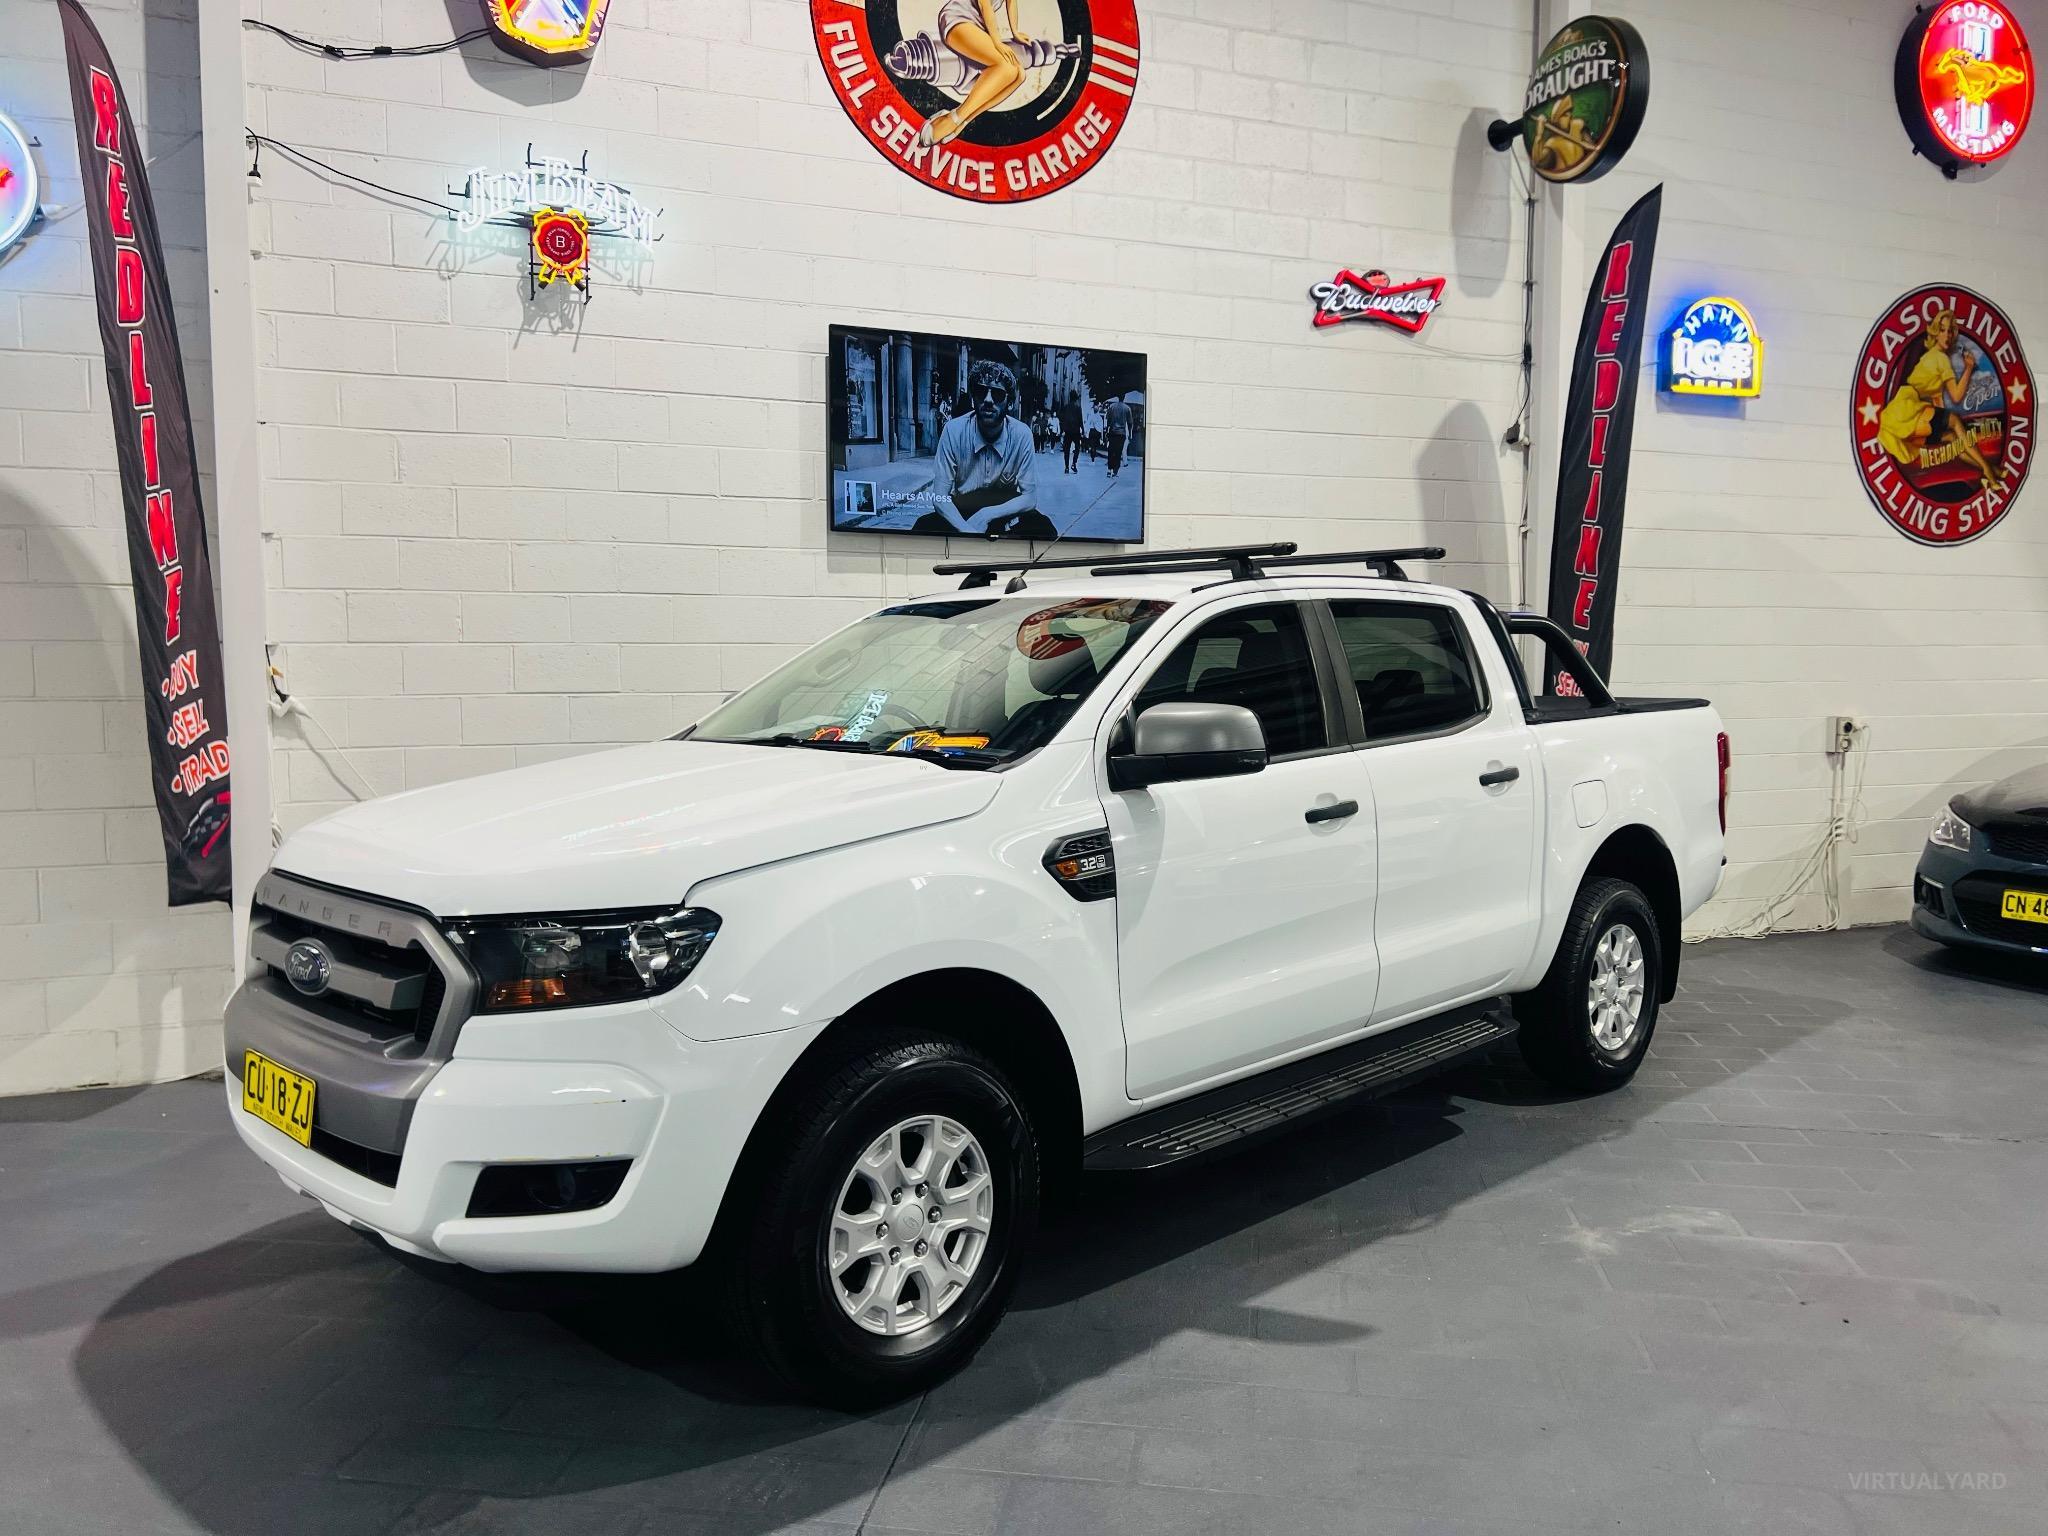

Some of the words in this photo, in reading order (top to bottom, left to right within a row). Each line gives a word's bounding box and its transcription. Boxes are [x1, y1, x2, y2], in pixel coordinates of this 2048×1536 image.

[1951, 2, 2004, 29] FORD
[1528, 51, 1562, 86] AMES
[1563, 40, 1608, 63] BOAG'S
[823, 20, 877, 110] FULL
[870, 105, 996, 194] SERVICE
[1004, 102, 1112, 191] GARAGE
[1932, 107, 2015, 154] MUSTANG
[1310, 282, 1440, 314] Budweiser
[1684, 304, 1748, 342] HAHN
[90, 65, 183, 646] REDLINE
[1865, 296, 2017, 389] GASOLINE
[1573, 240, 1633, 630] REDLINE
[881, 489, 916, 502] Hearts
[926, 492, 952, 503] Mess
[1862, 437, 1949, 535] FILLING
[1958, 415, 2030, 532] STATION
[173, 699, 210, 749] SELL
[180, 740, 231, 797] TRAD
